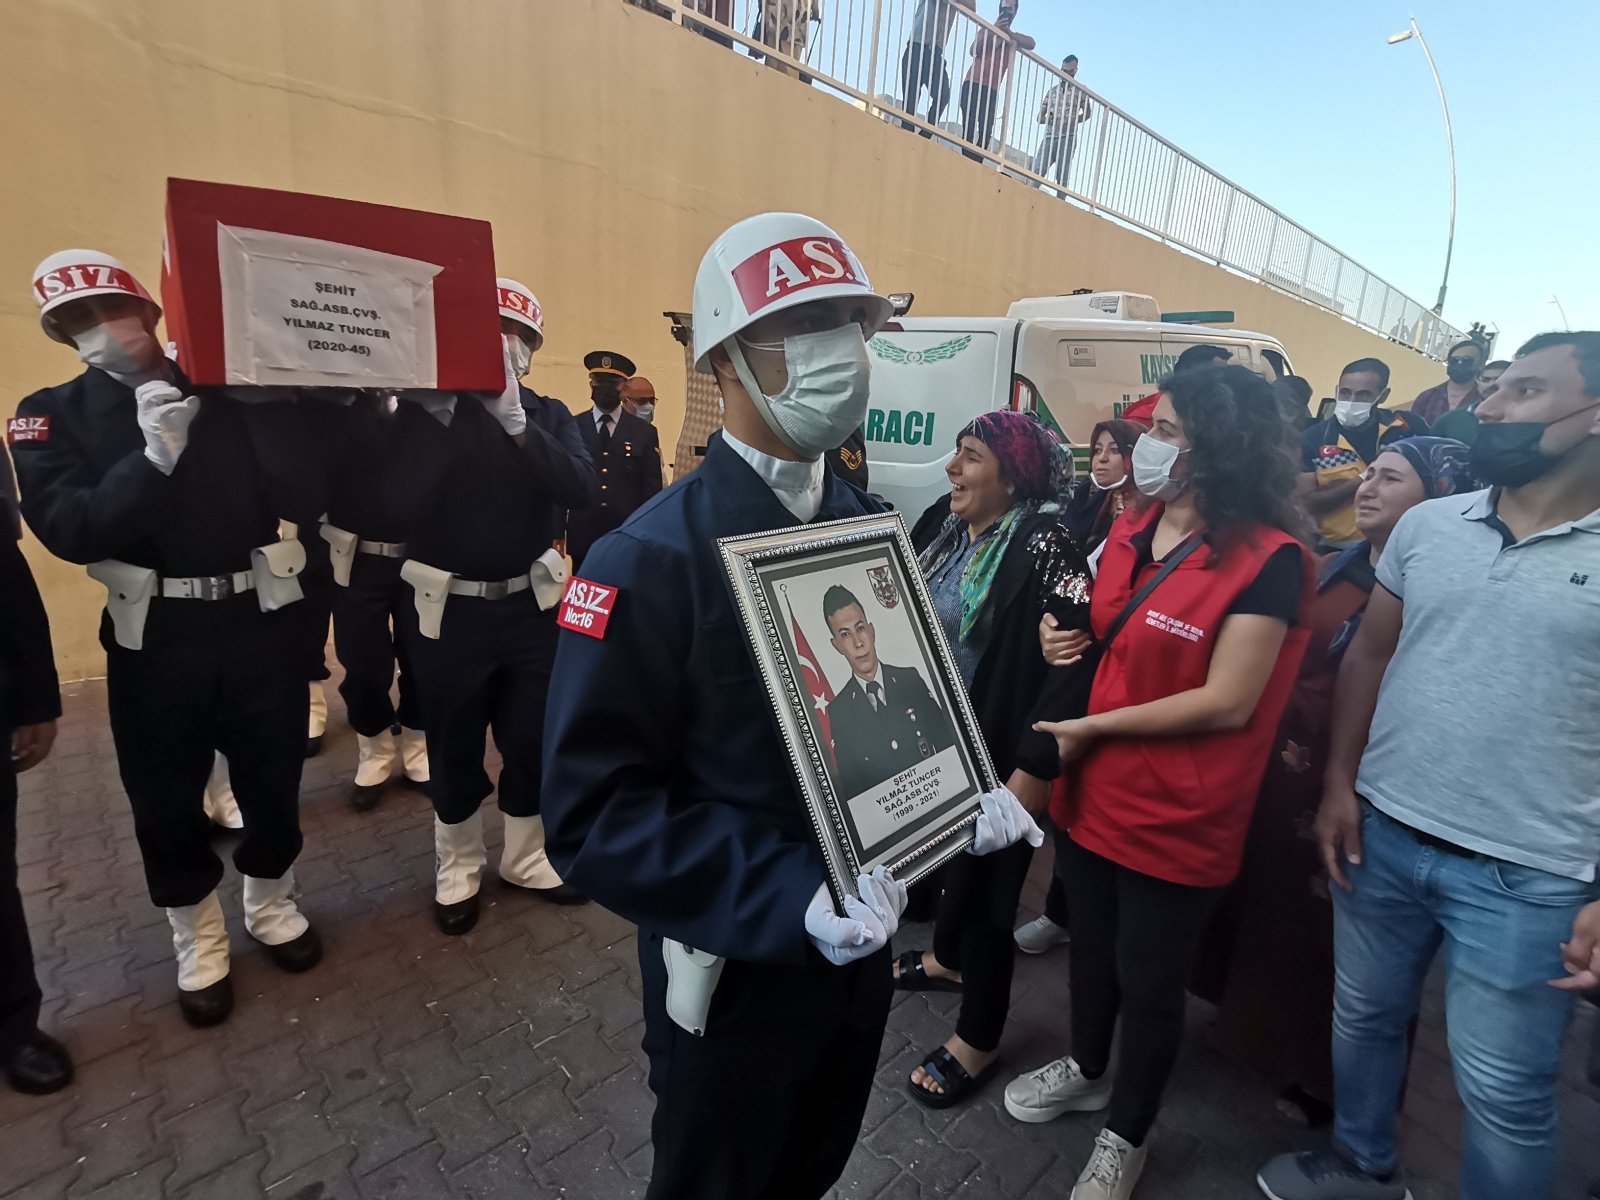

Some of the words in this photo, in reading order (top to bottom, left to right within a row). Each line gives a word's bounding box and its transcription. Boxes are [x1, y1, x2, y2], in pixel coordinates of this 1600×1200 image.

[315, 281, 356, 297] ŞEHİT
[290, 299, 381, 320] SAĞ.ASB.ÇVŞ.
[282, 317, 335, 332] YILMAZ
[338, 324, 391, 339] TUNCER
[308, 340, 371, 357] (2020-45)
[860, 409, 935, 446] RACI
[564, 606, 594, 628] No:16
[876, 784, 908, 806] YILMAZ
[908, 766, 941, 789] TUNCER
[893, 767, 918, 787] ŞEHİT
[884, 778, 942, 814] SAĞ.ASB.ÇVŞ.
[892, 804, 914, 821] (1999
[919, 789, 940, 806] 2021)
